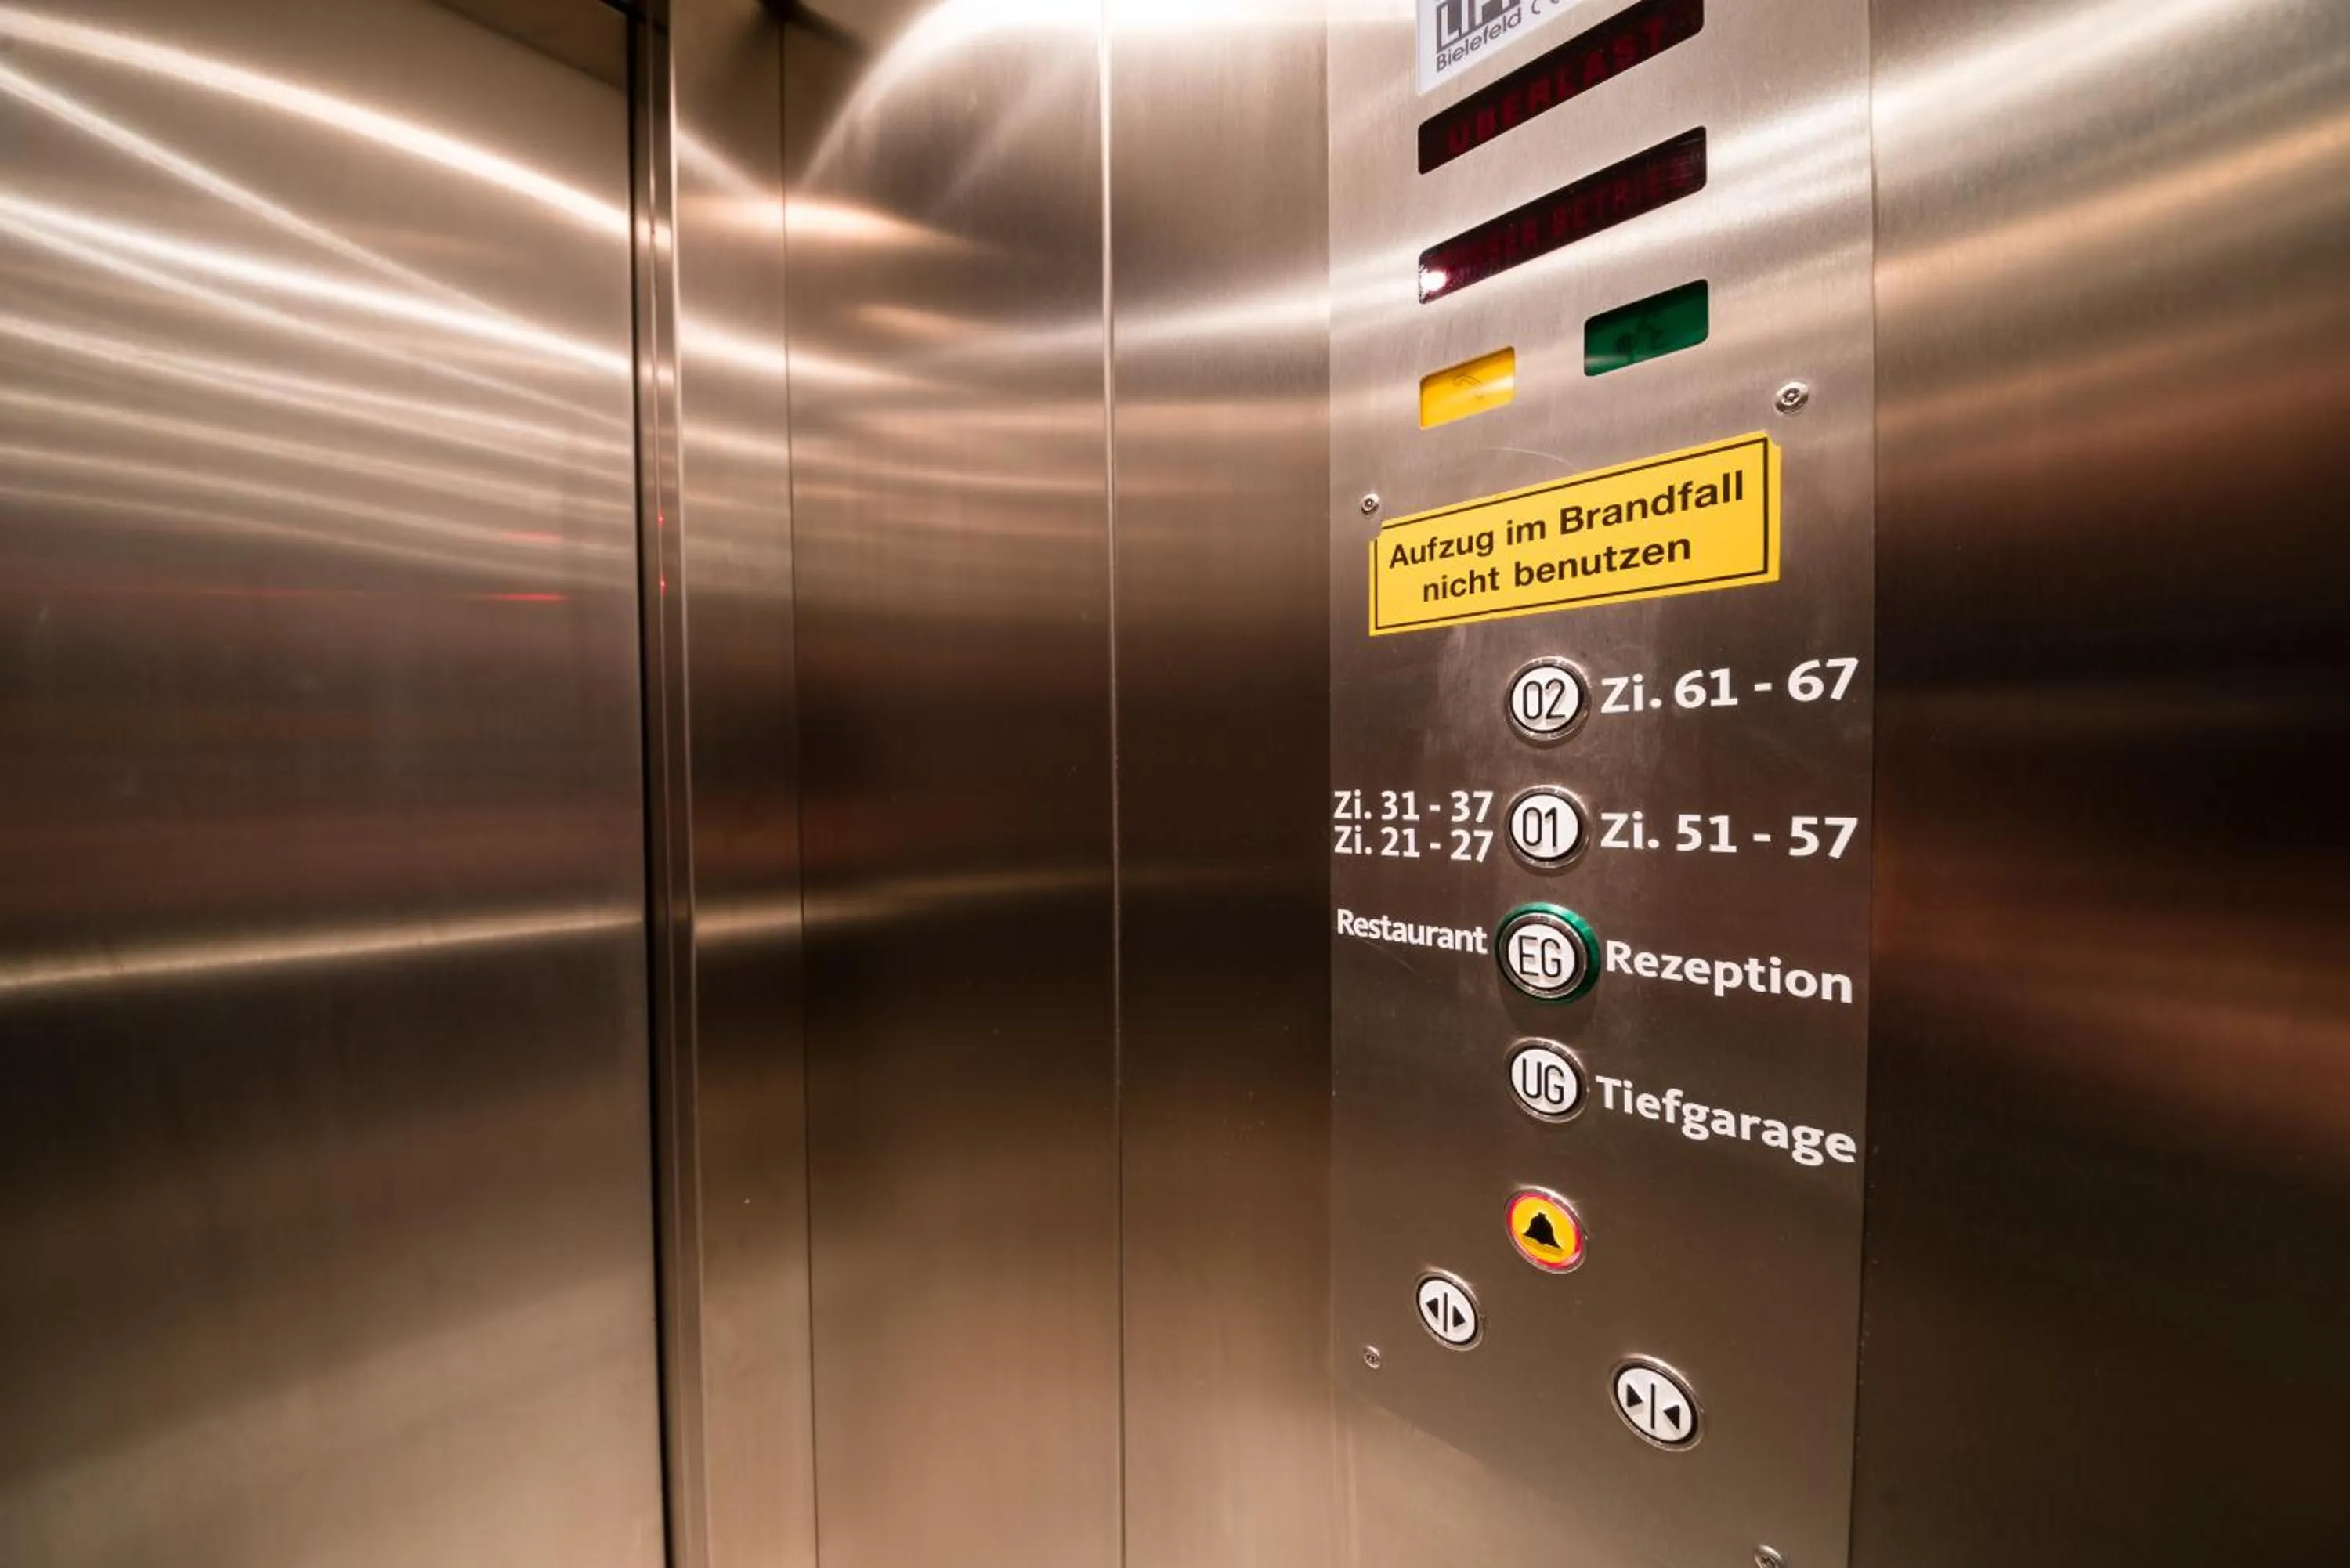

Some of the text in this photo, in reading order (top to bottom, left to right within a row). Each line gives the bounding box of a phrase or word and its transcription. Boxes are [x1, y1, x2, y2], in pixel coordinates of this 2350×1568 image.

[1436, 7, 1522, 72] Bielefeld
[1437, 0, 1521, 52] LIF
[1390, 470, 1743, 569] Aufzug im Brandfall
[1423, 539, 1690, 602] nicht benutzen
[1523, 678, 1566, 720] 02
[1600, 657, 1859, 714] Zi. 61 - 67
[1333, 789, 1372, 820] Zi.
[1381, 790, 1420, 821] 31
[1450, 790, 1494, 823] 37
[1522, 807, 1558, 847] 01
[1333, 824, 1373, 855] Zi.
[1380, 826, 1420, 858] 21
[1450, 828, 1494, 863] 27
[1600, 811, 1858, 859] Zi. 51 - 57
[1337, 908, 1488, 955] Restaurant
[1518, 935, 1562, 978] EG
[1606, 939, 1853, 1003] Rezeption
[1522, 1058, 1564, 1105] UG
[1595, 1075, 1856, 1166] Tiefgarage
